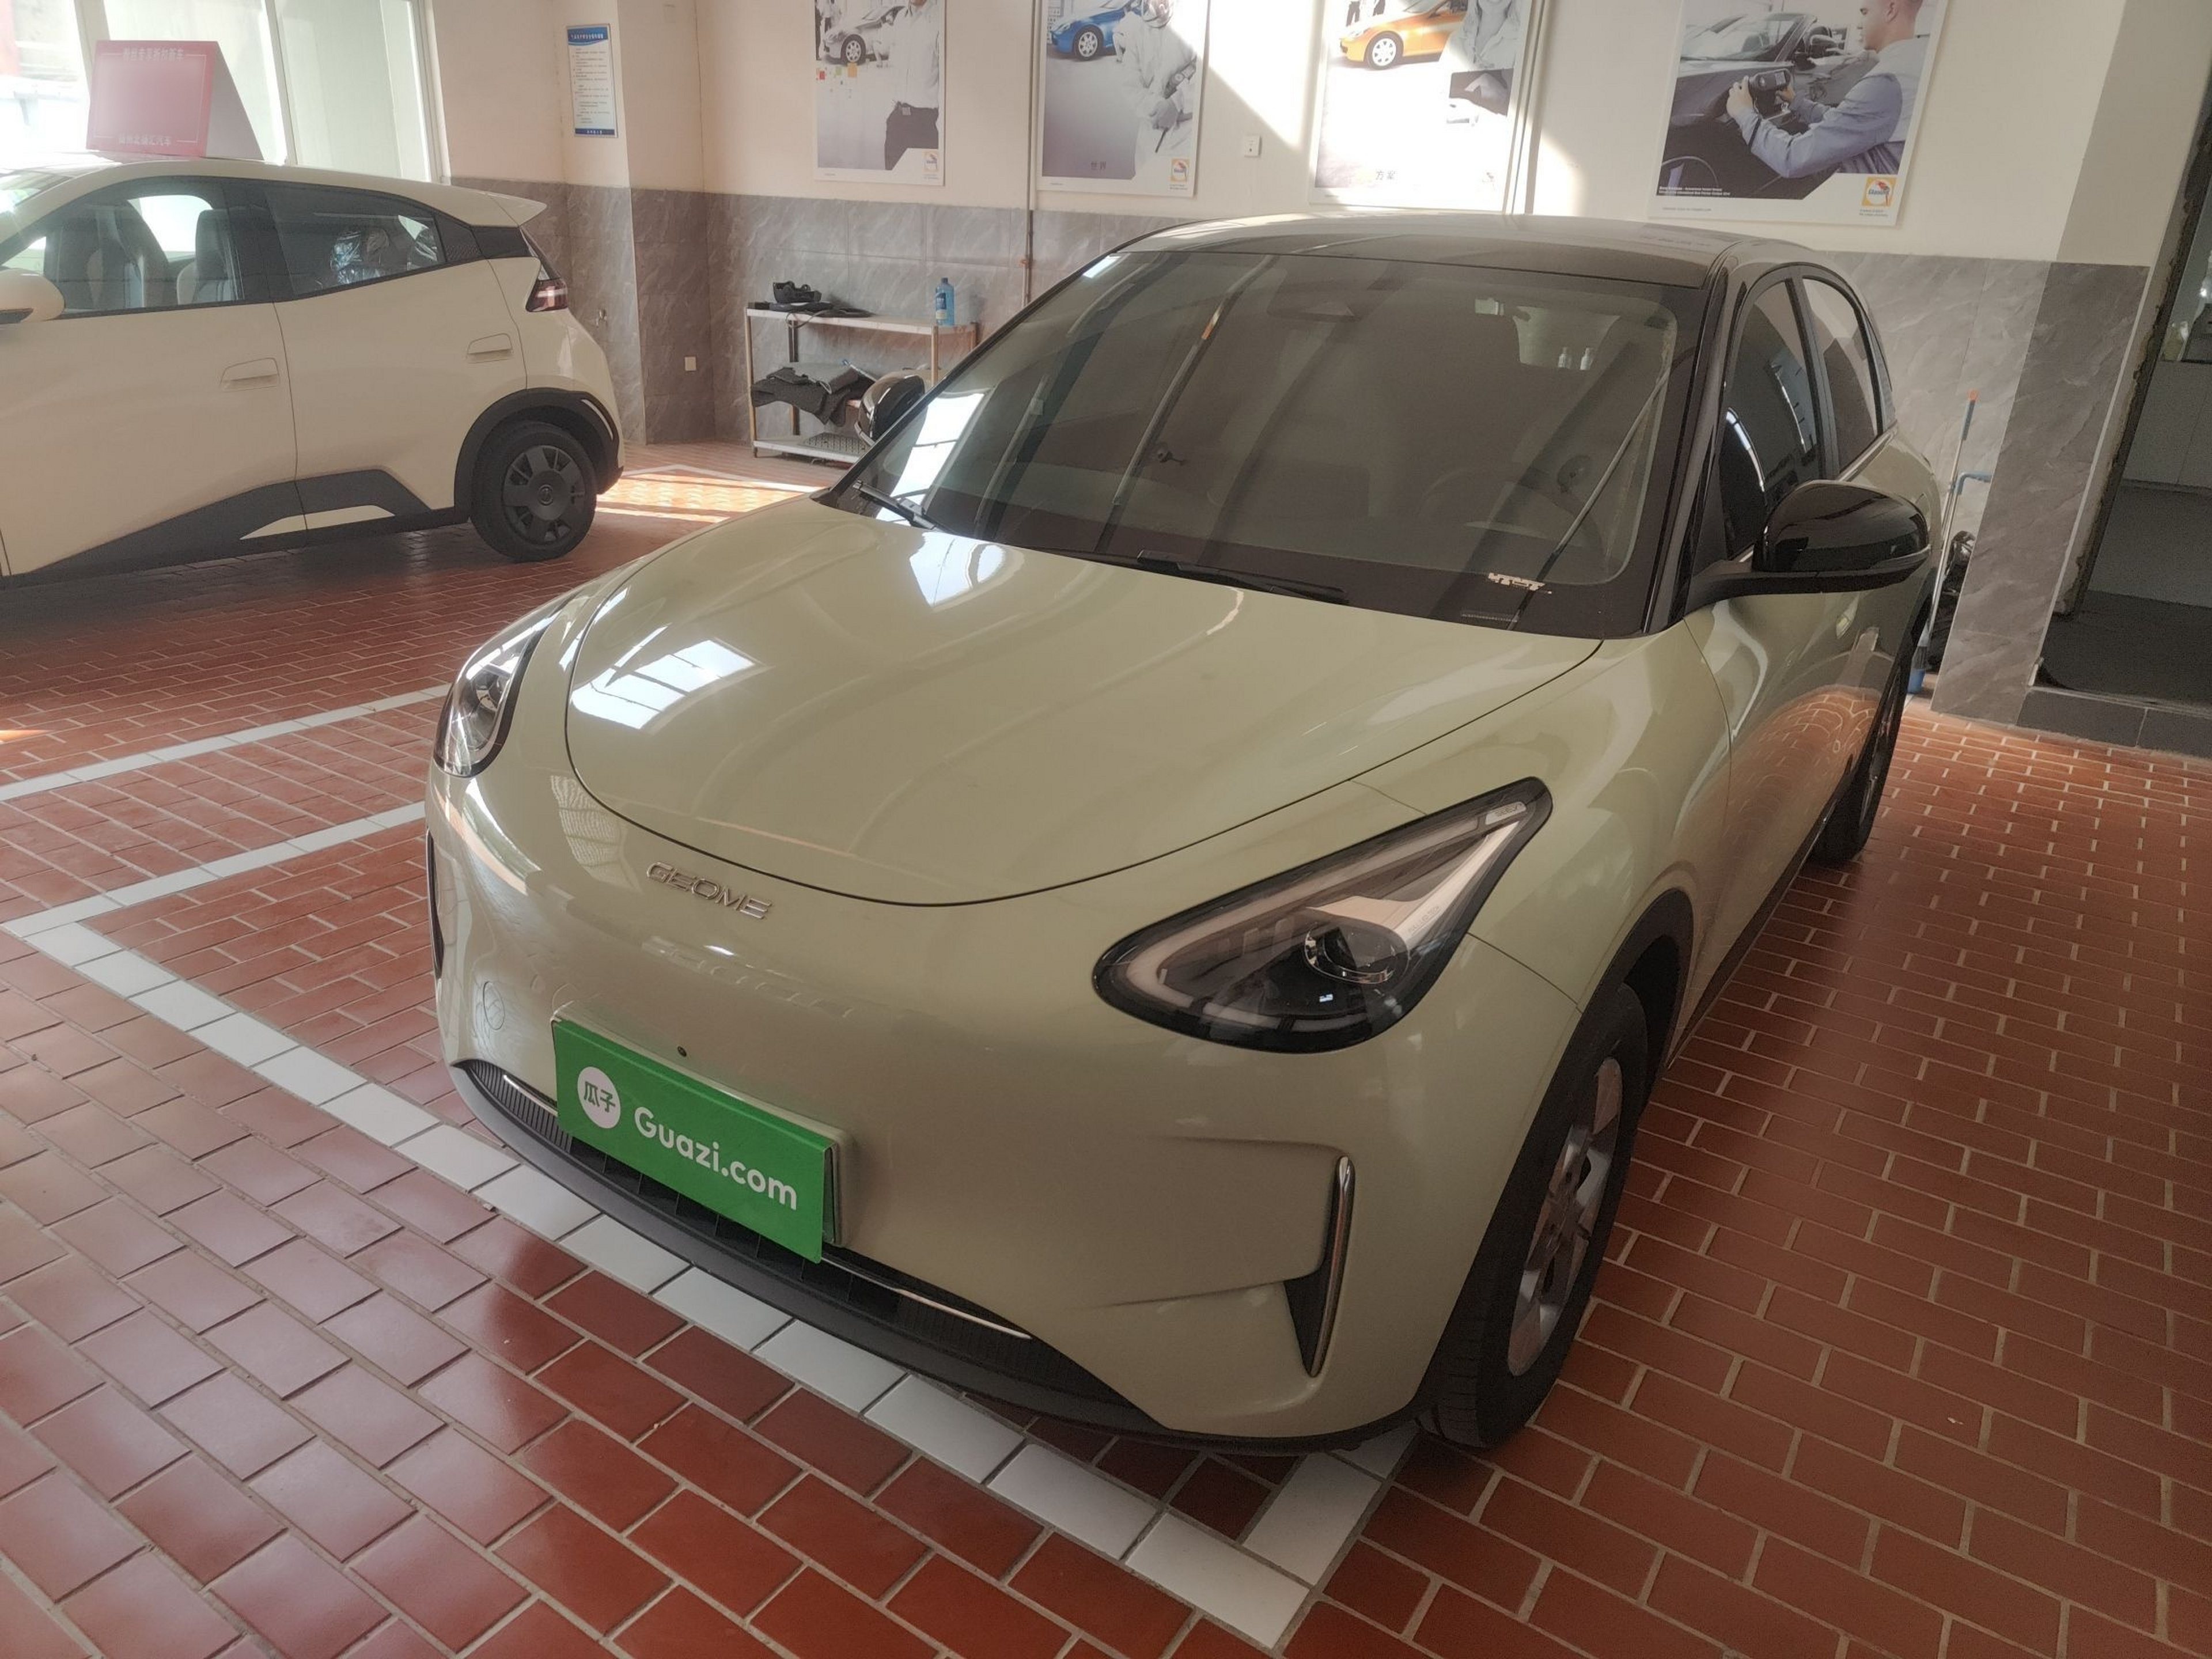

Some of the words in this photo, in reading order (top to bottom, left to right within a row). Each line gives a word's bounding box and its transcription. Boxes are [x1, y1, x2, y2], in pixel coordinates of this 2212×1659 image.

[646, 862, 772, 920] GEOME
[584, 1081, 616, 1112] 瓜子
[634, 1106, 797, 1210] Guazi.com
